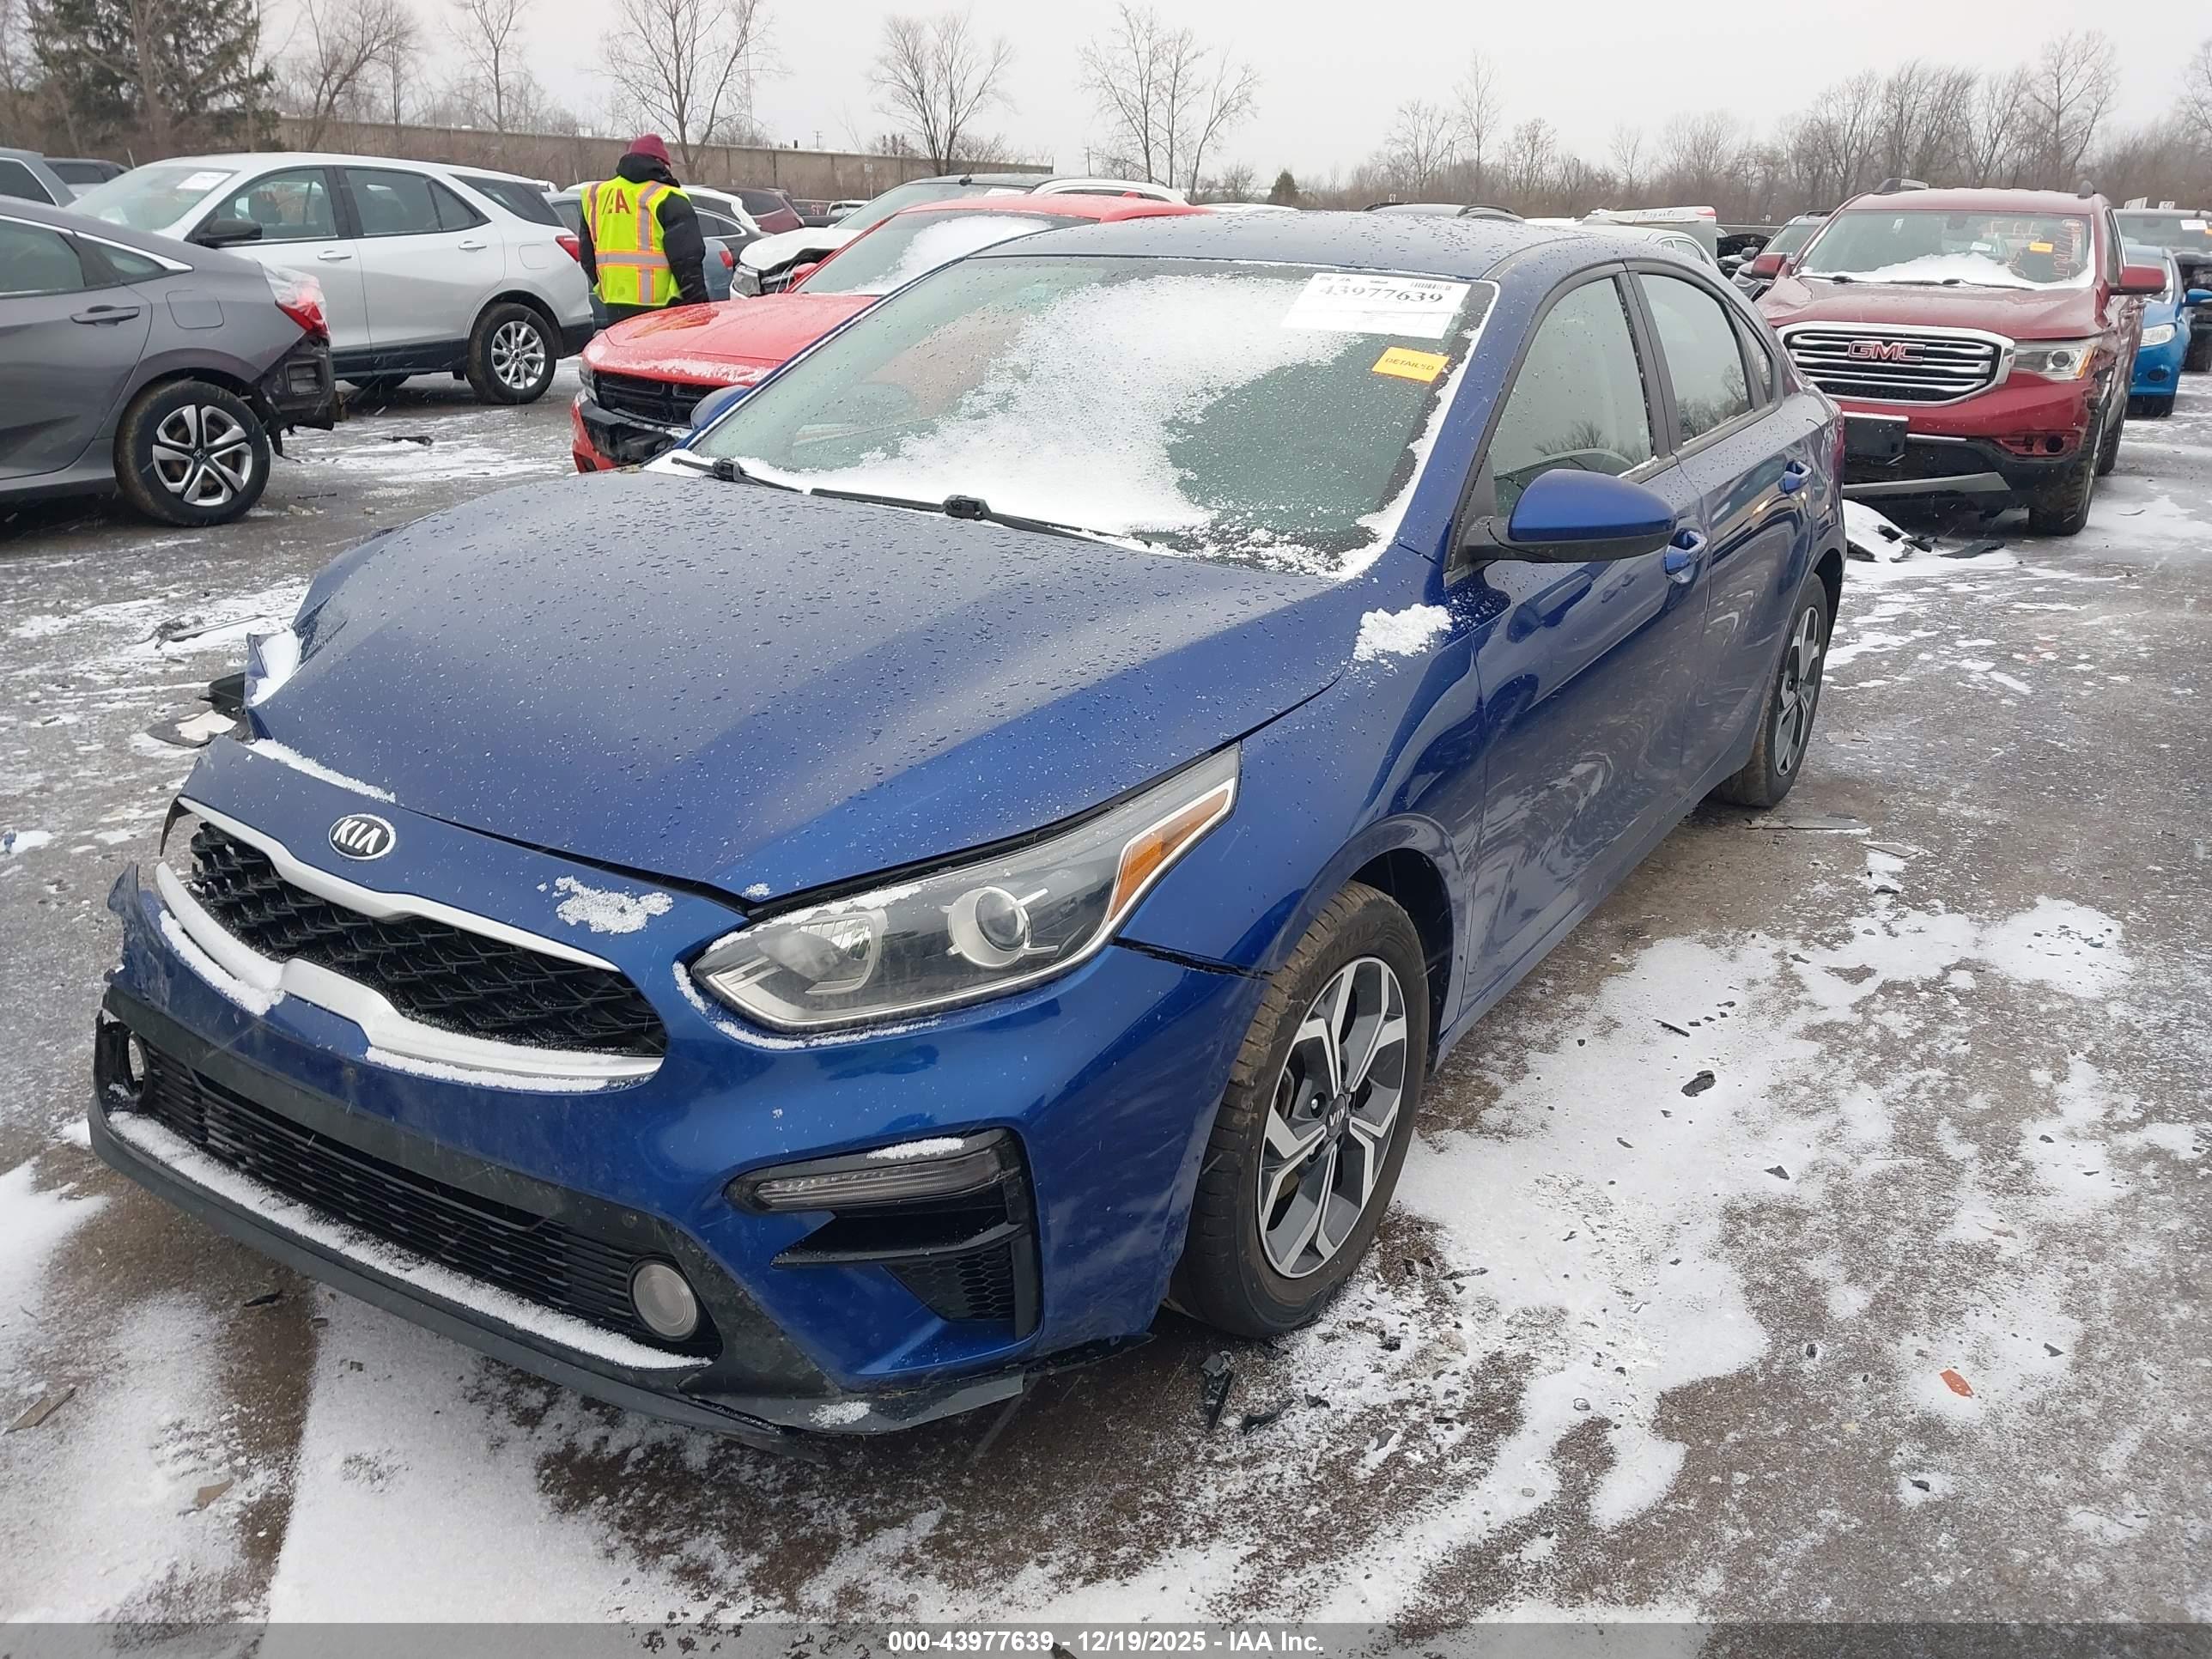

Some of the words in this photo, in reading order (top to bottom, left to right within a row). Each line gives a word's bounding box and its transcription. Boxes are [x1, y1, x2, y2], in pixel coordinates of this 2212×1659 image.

[1318, 284, 1443, 303] 43977639
[1847, 339, 1926, 362] GMC
[332, 818, 382, 854] KIA
